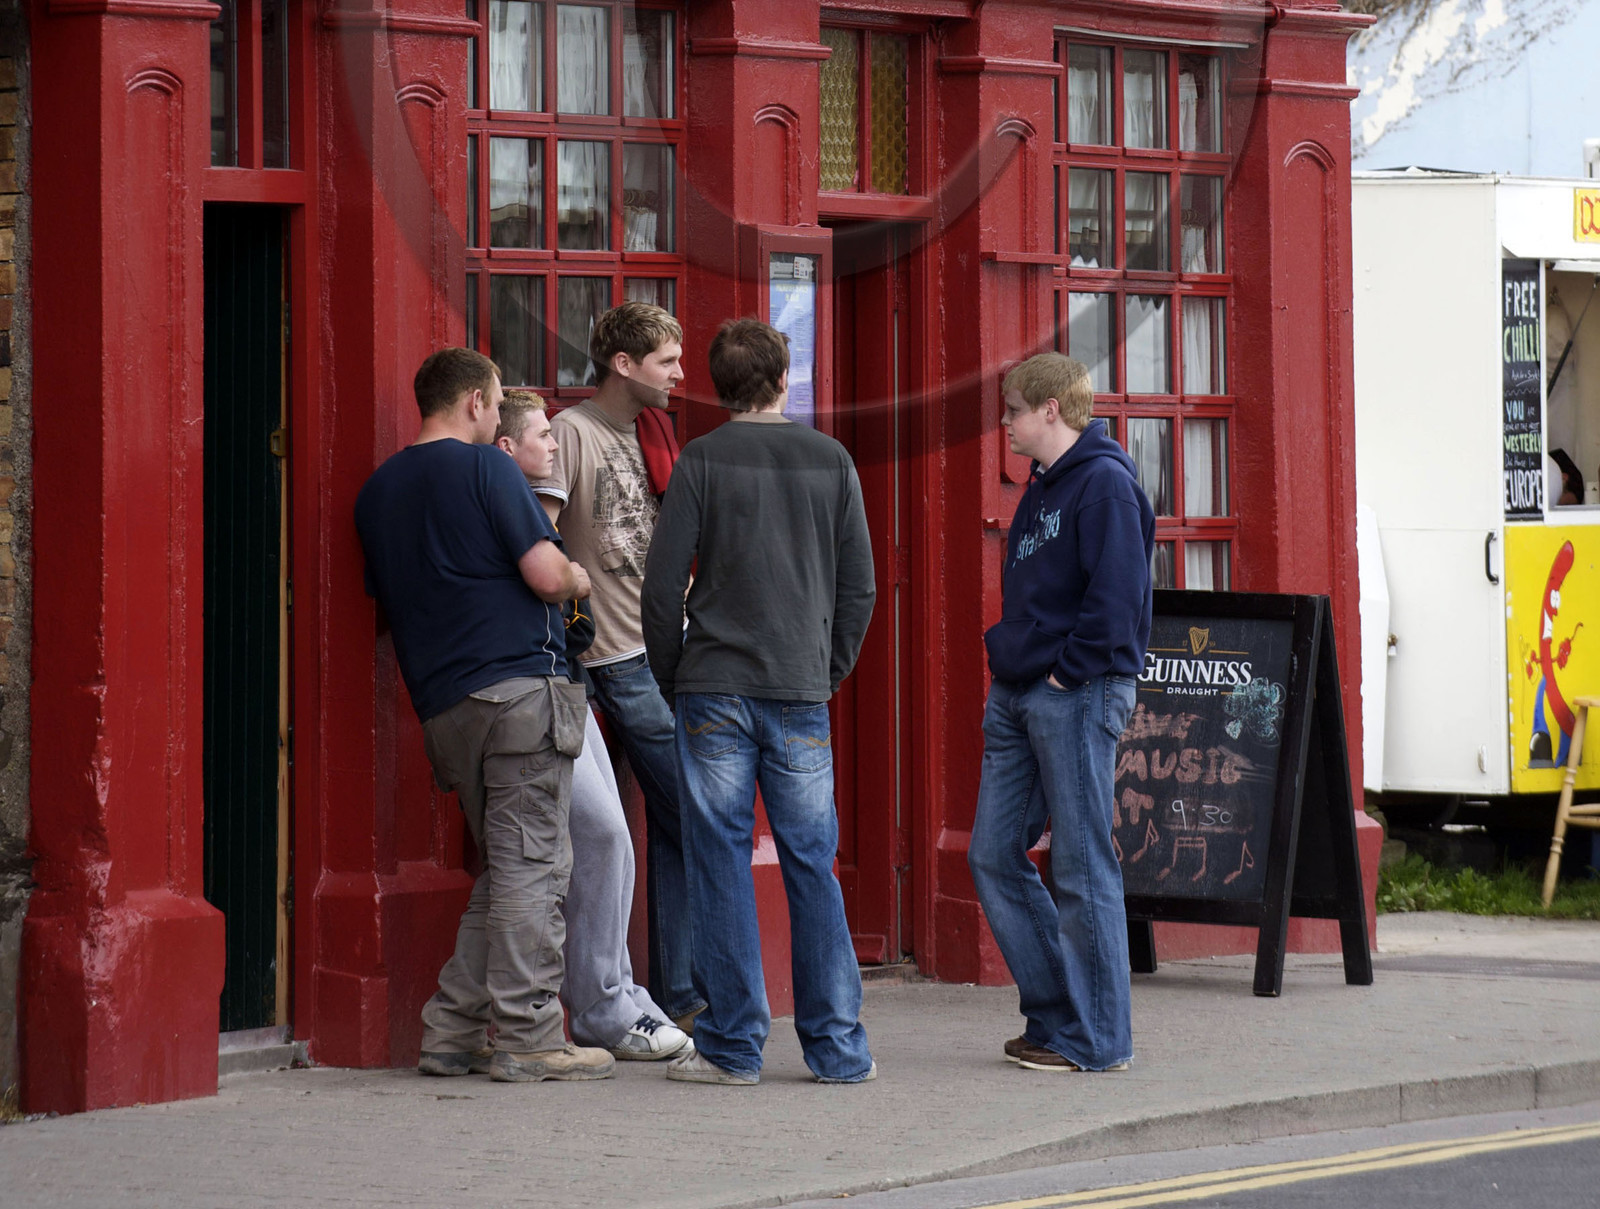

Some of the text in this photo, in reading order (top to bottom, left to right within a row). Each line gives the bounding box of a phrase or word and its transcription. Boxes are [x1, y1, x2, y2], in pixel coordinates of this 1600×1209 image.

[1504, 280, 1537, 318] FREE
[1505, 399, 1525, 422] YOU
[1503, 469, 1543, 511] EUROPE
[1166, 686, 1219, 697] DRAUGHT
